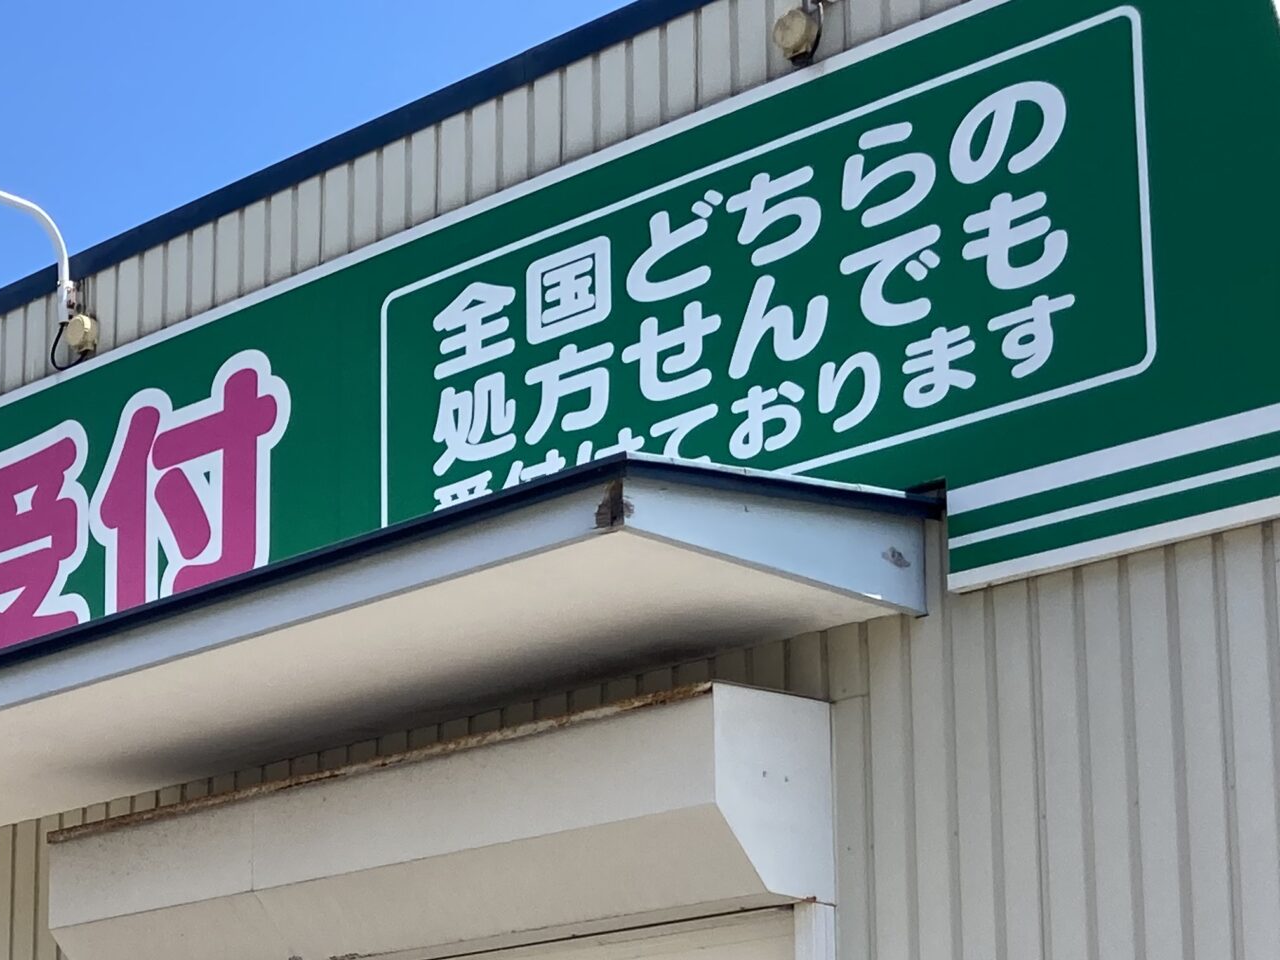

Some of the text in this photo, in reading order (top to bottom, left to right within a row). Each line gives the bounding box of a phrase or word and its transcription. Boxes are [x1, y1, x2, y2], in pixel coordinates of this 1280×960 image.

[432, 81, 1067, 380] 全国どちらの
[432, 190, 1069, 476] 処方せんでも
